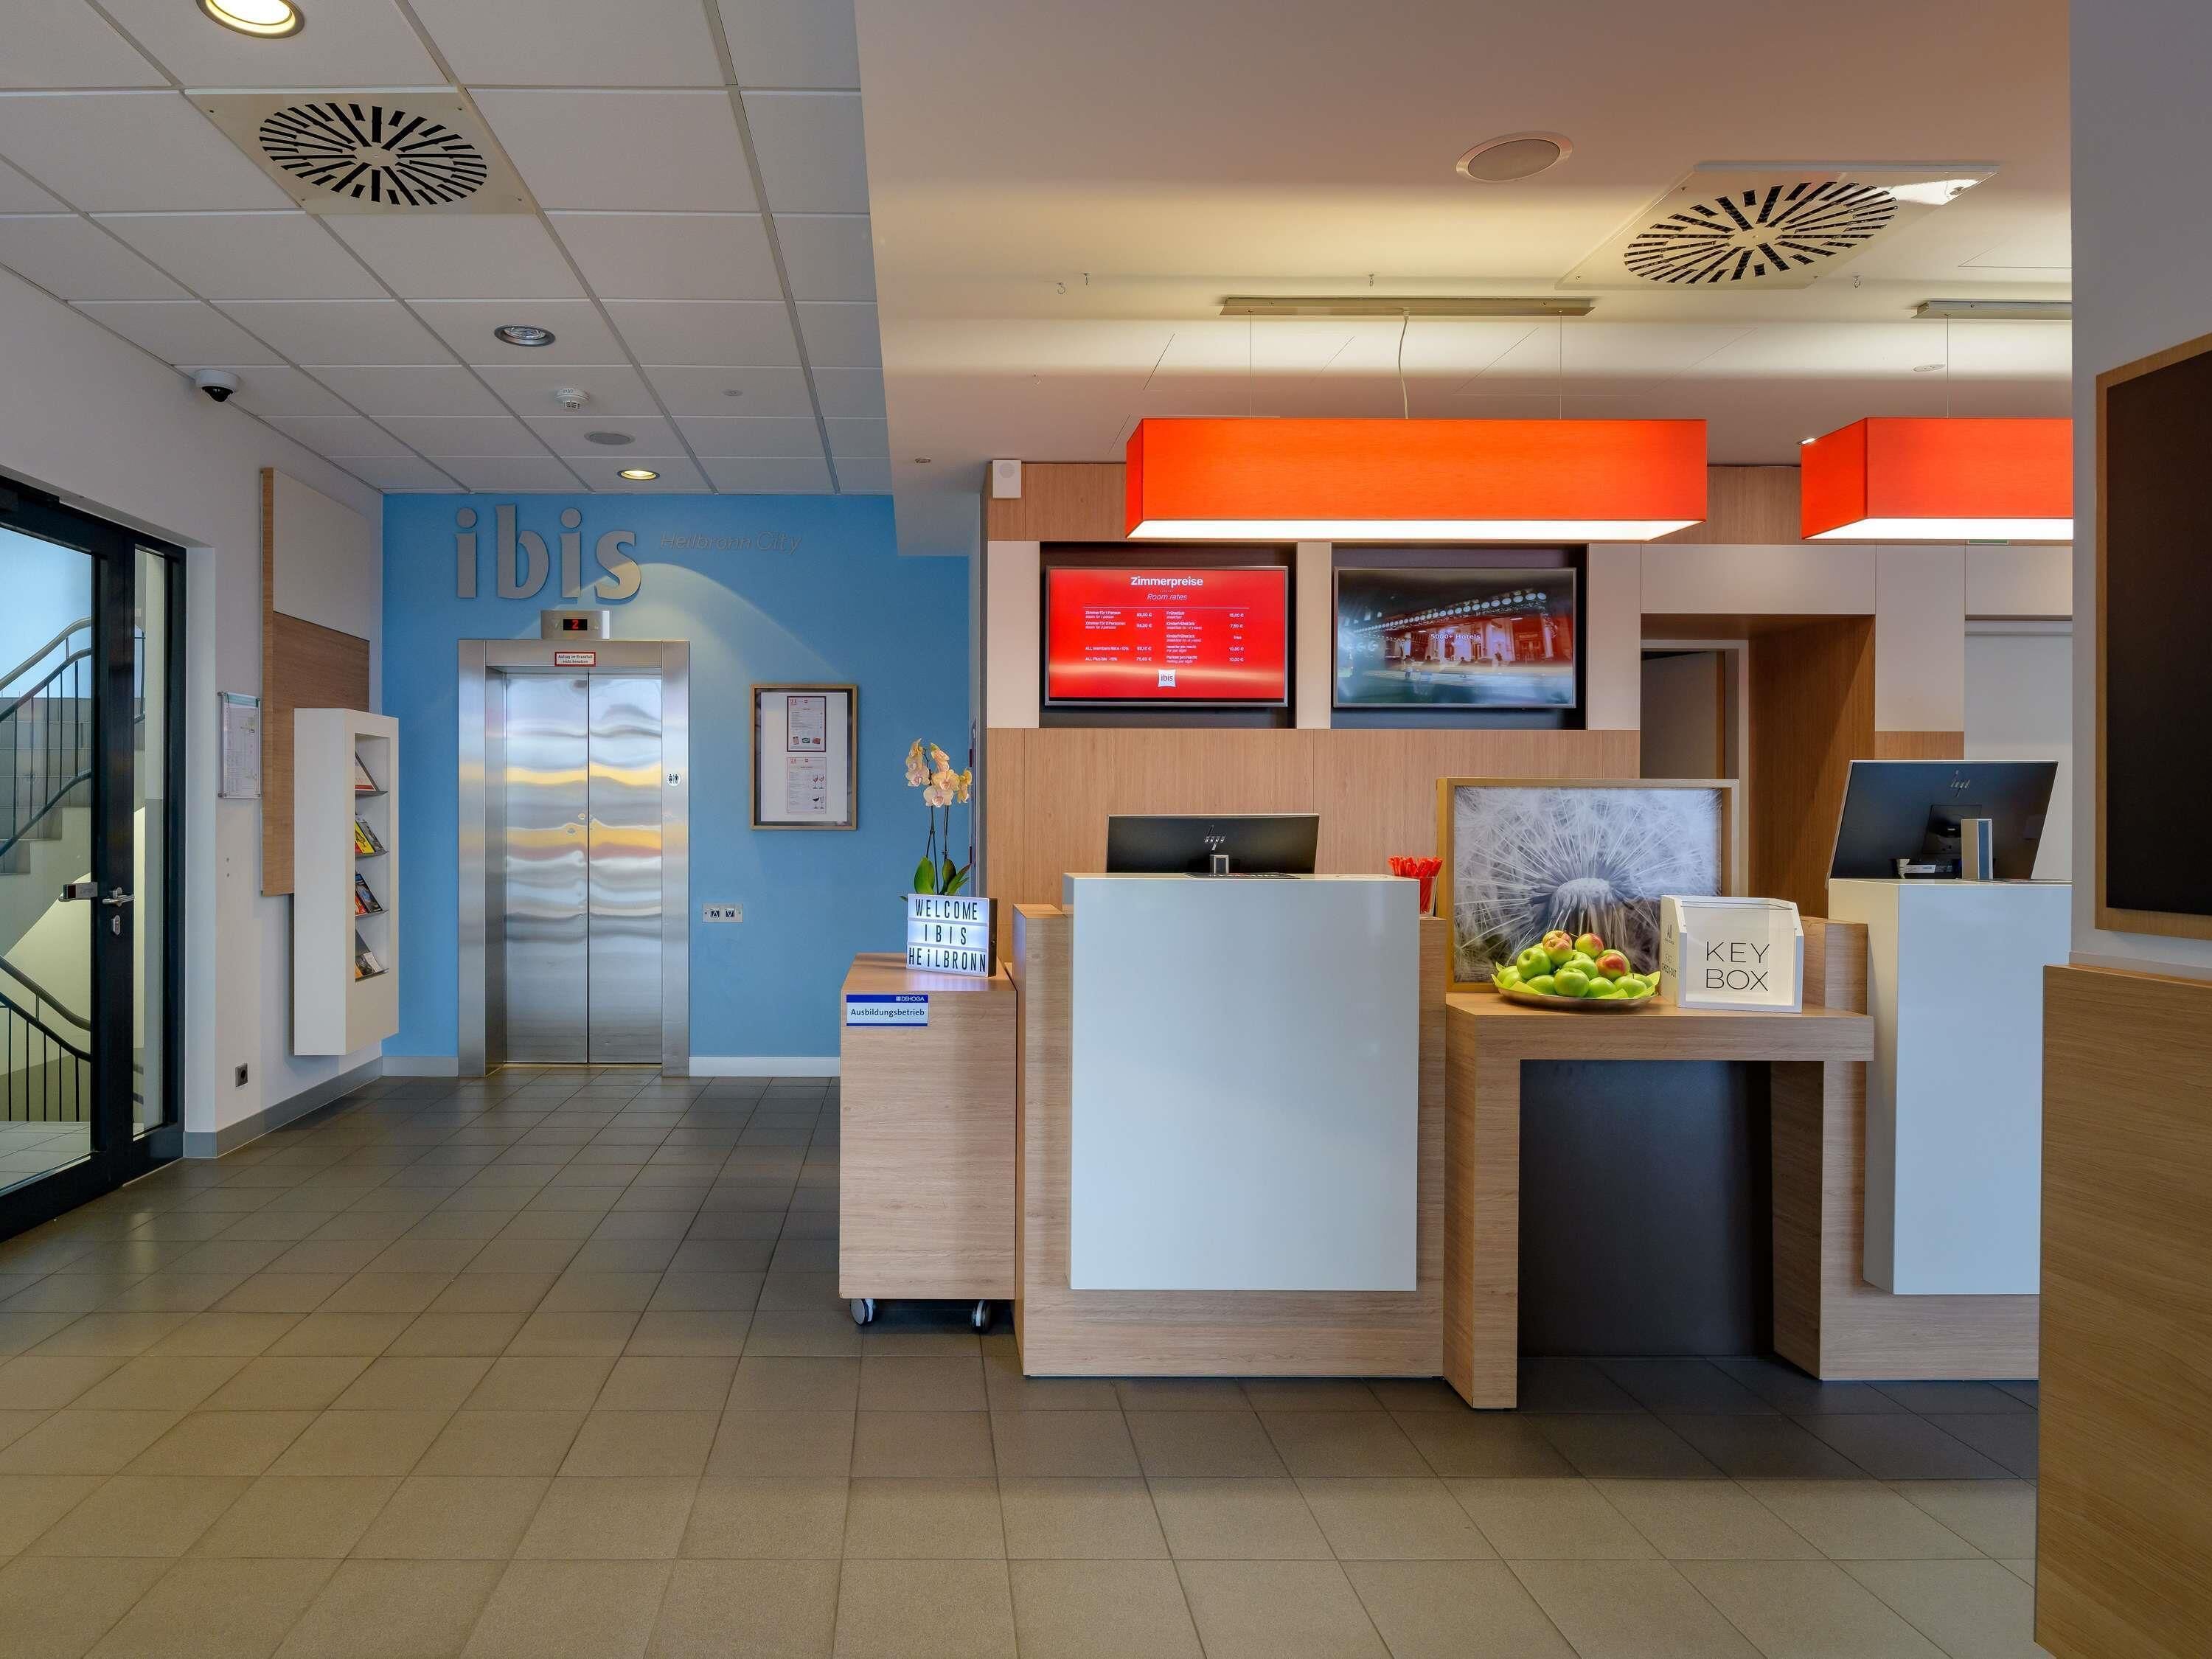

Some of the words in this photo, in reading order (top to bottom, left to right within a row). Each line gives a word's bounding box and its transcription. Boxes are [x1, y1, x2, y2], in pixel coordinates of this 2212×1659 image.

[455, 504, 641, 599] ibis
[660, 531, 751, 550] Heilbronn
[756, 530, 802, 554] City
[1130, 576, 1203, 588] Zimmerpreise
[572, 620, 579, 629] 2
[915, 898, 978, 920] WELCOME
[924, 924, 967, 945] IBIS
[1706, 941, 1770, 964] KEY
[1705, 968, 1769, 992] BOX
[850, 1009, 925, 1018] Ausbildungsbetrieb
